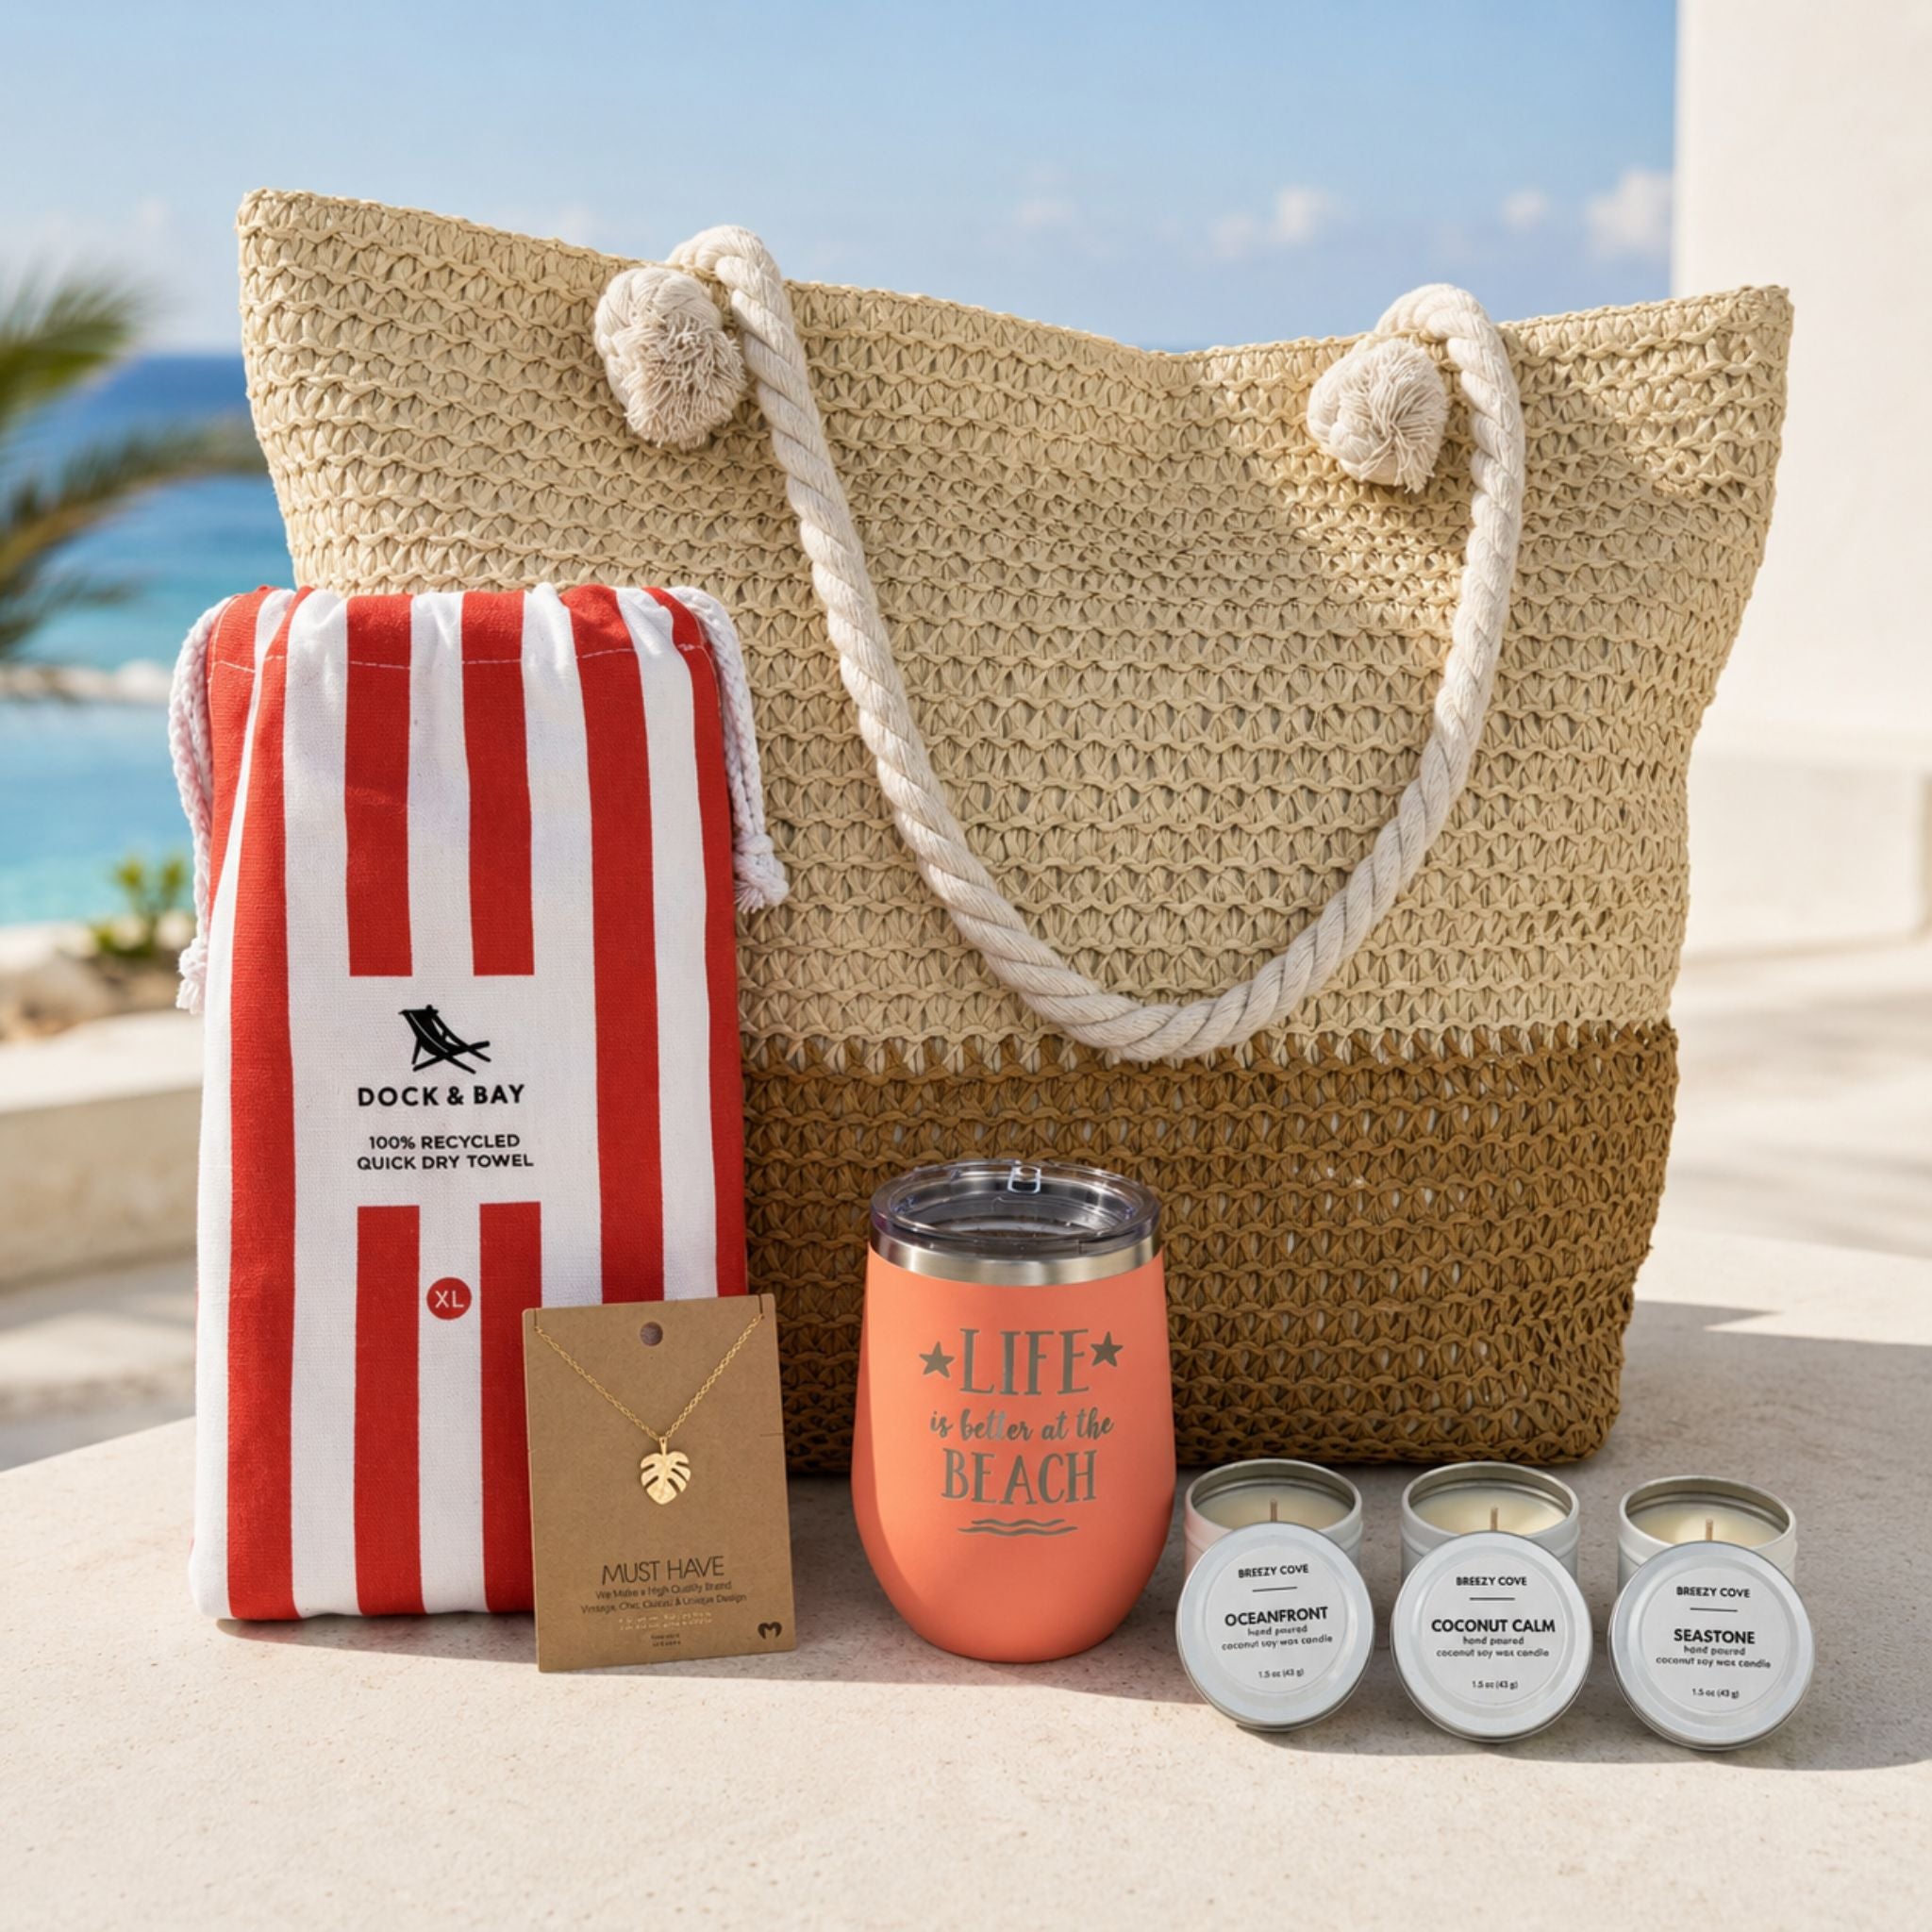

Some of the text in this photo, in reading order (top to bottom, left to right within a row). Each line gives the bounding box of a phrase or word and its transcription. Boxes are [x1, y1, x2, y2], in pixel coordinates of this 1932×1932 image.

[358, 1084, 525, 1108] DOCK & BAY
[369, 1134, 521, 1150] 100% RECYCLED
[357, 1153, 535, 1171] QUICK DRY TOWEL
[435, 1290, 465, 1308] XL
[959, 1327, 1090, 1396] LIFE
[930, 1407, 1115, 1441] is better at the
[941, 1447, 1098, 1506] BEACH
[602, 1555, 725, 1586] MUST HAVE
[1238, 1563, 1309, 1578] BREEZY COVE
[1456, 1576, 1527, 1586] BREEZY COVE
[1676, 1586, 1751, 1598] BREEZY COVE
[1224, 1607, 1328, 1626] OCEANFRONT
[1431, 1619, 1556, 1633] COCONUT CALM
[1222, 1640, 1259, 1651] coconut
[1301, 1634, 1333, 1644] candle
[1462, 1636, 1488, 1645] hand
[1674, 1628, 1756, 1644] SEASTONE
[1436, 1649, 1475, 1657] coconut
[1476, 1650, 1492, 1659] soy
[1683, 1645, 1708, 1655] hand
[1656, 1657, 1695, 1665] coconut
[1697, 1658, 1714, 1668] soy
[1472, 1680, 1484, 1689] 1.5
[1691, 1688, 1705, 1696] 1.5
